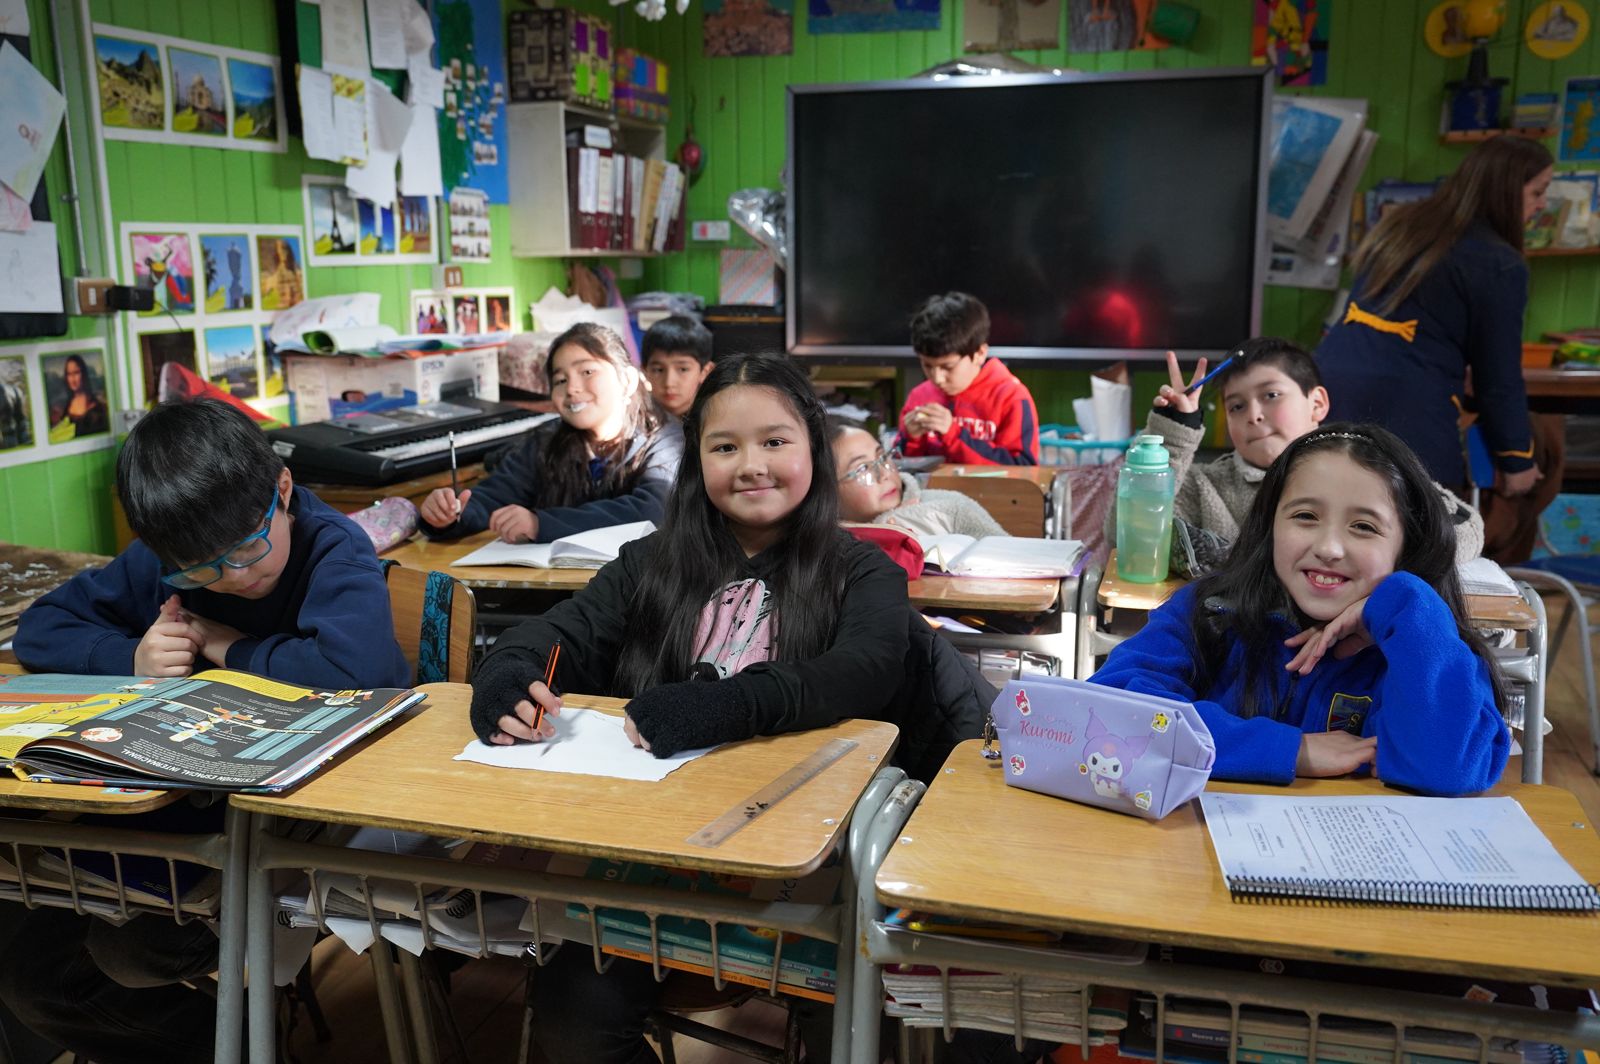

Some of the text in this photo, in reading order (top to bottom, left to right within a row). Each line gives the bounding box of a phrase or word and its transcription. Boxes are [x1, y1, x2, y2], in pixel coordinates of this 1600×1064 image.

[1019, 719, 1075, 745] Kuromi
[121, 748, 181, 773] INTERNACIONAL
[181, 769, 218, 781] ESPACIAL
